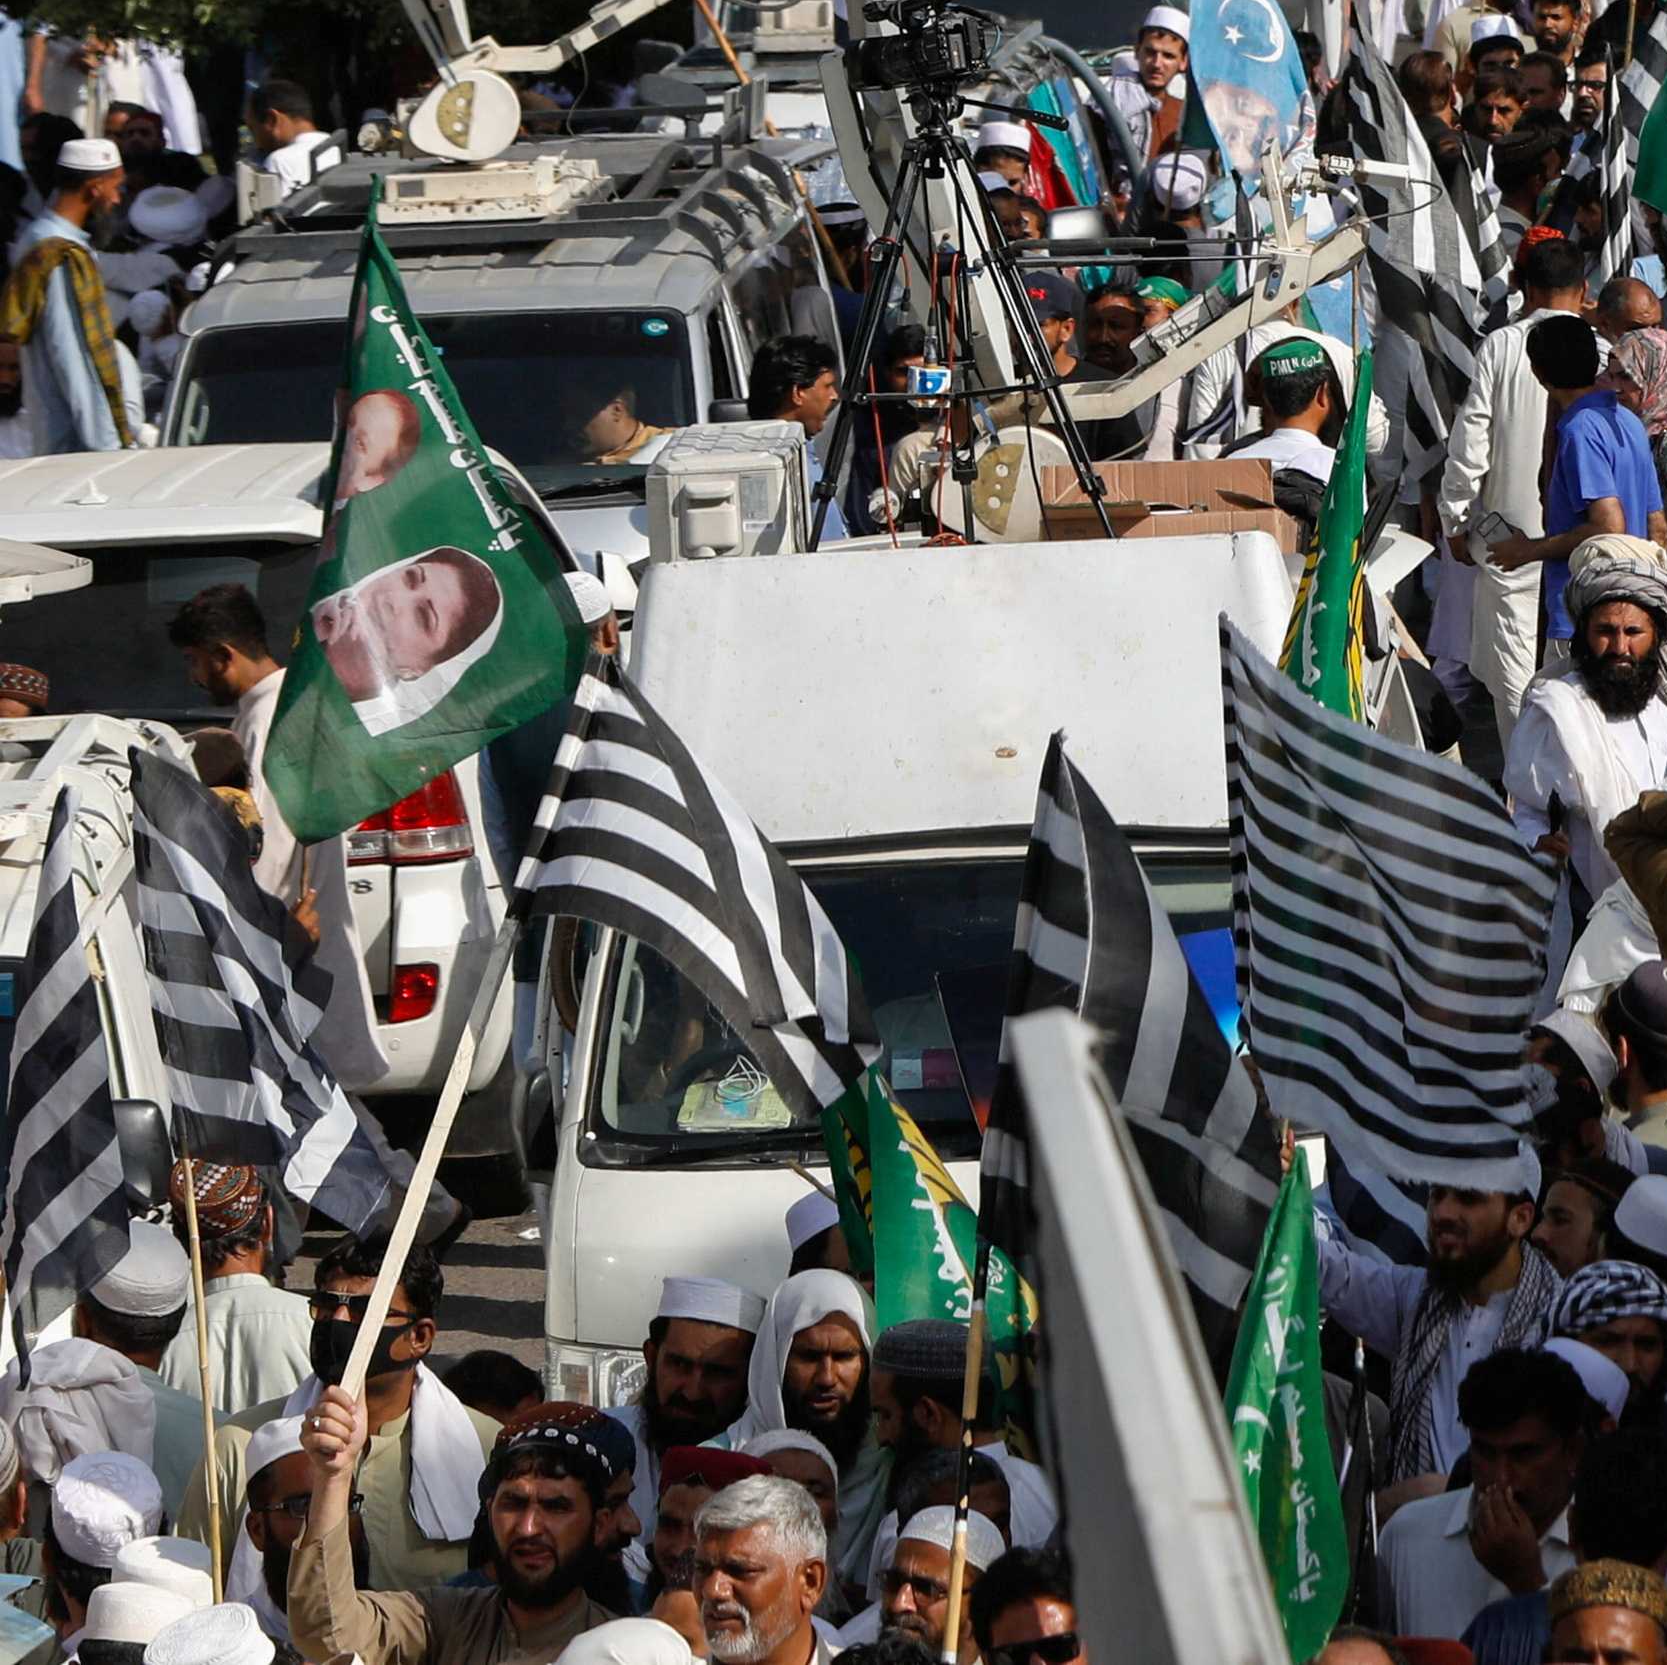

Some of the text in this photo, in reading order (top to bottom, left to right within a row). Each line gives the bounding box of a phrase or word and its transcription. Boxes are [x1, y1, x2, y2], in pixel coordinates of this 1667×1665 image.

[370, 305, 524, 552] پاکستان مسلم لیگ ن
[1277, 1382, 1305, 1471] مسلم
[1288, 1477, 1323, 1604] پاکستان
